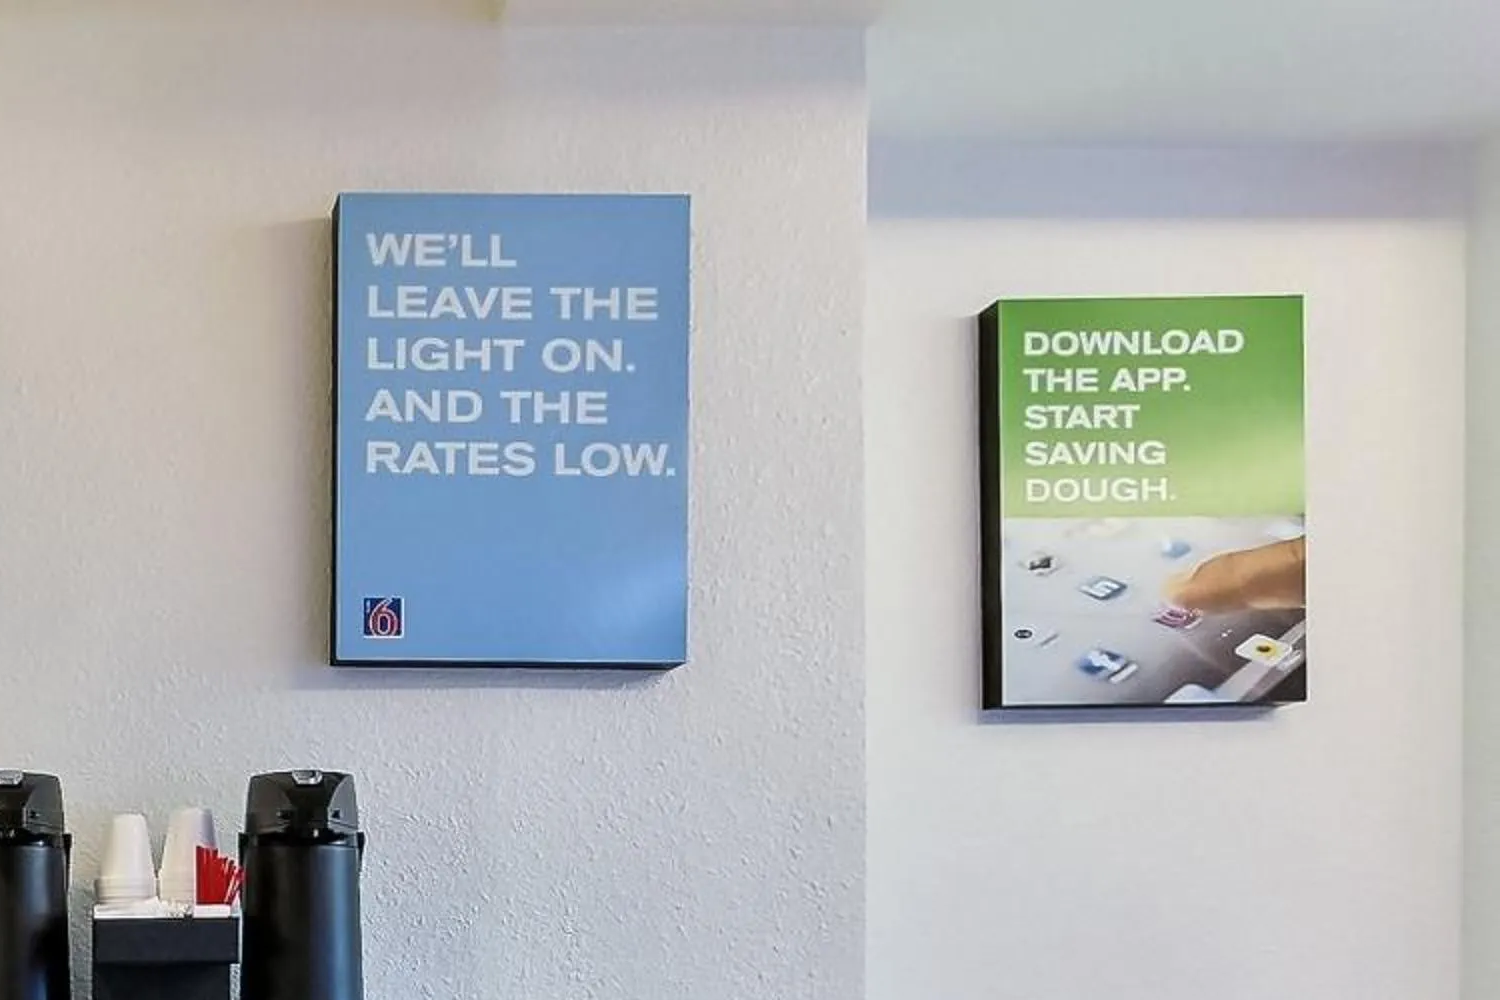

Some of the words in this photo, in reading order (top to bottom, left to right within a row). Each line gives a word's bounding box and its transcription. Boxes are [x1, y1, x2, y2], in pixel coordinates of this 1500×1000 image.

[366, 233, 516, 267] WE'LL
[368, 285, 532, 320] LEAVE
[550, 287, 658, 321] THE
[367, 337, 525, 371] LIGHT
[542, 339, 635, 373] ON.
[1024, 330, 1244, 356] DOWNLOAD
[1023, 368, 1098, 392] THE
[1110, 367, 1190, 392] APP.
[365, 389, 482, 423] AND
[500, 391, 608, 425] THE
[1024, 404, 1140, 430] START
[367, 441, 536, 477] RATES
[555, 443, 675, 477] LOW.
[1025, 440, 1166, 466] SAVING
[1026, 478, 1175, 502] DOUGH.
